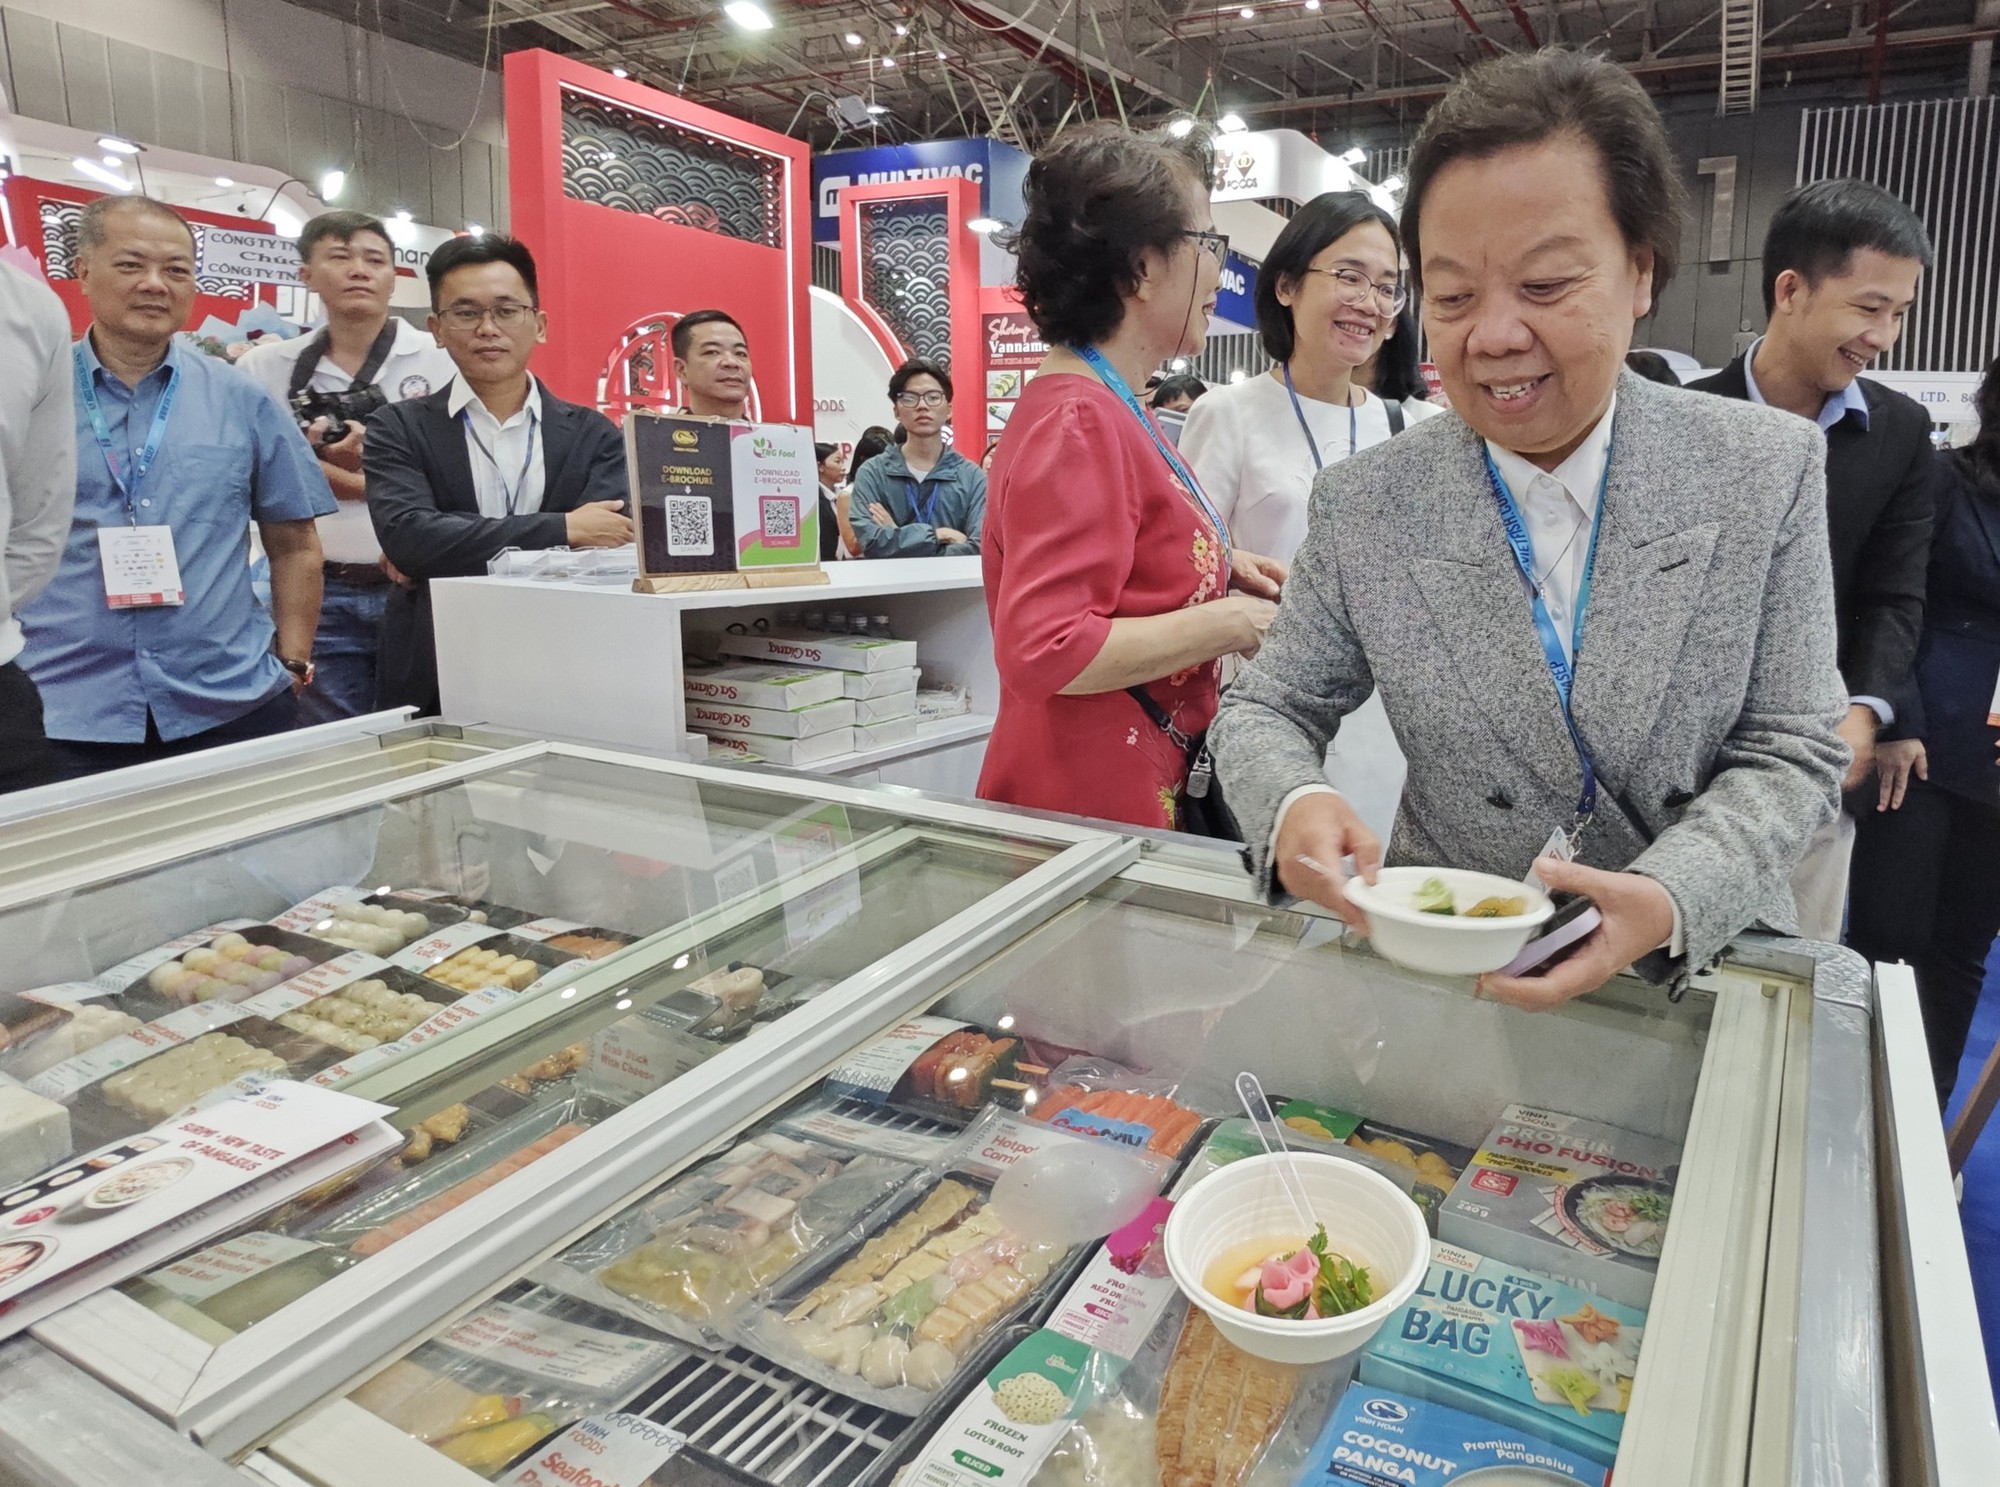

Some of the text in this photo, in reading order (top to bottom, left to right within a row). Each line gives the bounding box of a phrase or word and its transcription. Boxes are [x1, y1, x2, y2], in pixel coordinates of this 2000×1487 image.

[211, 232, 255, 247] CÔNG
[257, 237, 277, 248] TY
[239, 250, 301, 266] Chúc
[208, 262, 252, 278] CÔNG
[254, 268, 274, 279] TY
[1920, 391, 1950, 403] LTD.
[779, 449, 796, 458] Food
[660, 474, 714, 485] E-BROCHURE
[662, 465, 712, 476] DOWNLOAD
[755, 468, 801, 477] DOWNLOAD
[754, 477, 803, 485] E-BROCHURE
[768, 641, 822, 662] Sa Giang
[721, 685, 738, 699] Sa
[696, 707, 751, 728] Sa Giang
[1515, 1116, 1557, 1130] FOODS
[1519, 1109, 1548, 1121] VINH
[180, 1140, 203, 1149] OF
[218, 1135, 252, 1148] NEW
[245, 1143, 286, 1160] TASTE
[991, 1135, 1040, 1153] Hotpo
[1501, 1124, 1616, 1155] PROTEIN
[1496, 1135, 1659, 1180] PHO FUSION
[1436, 1254, 1474, 1269] FOODS
[1440, 1247, 1467, 1260] VINH
[1090, 1283, 1110, 1295] RED
[1414, 1266, 1554, 1320] LUCKY
[1400, 1307, 1492, 1356] BAG
[581, 1420, 611, 1440] VINH
[983, 1419, 1029, 1442] FROZEN
[1354, 1416, 1404, 1434] VINH HOAN
[568, 1430, 608, 1455] FOODS
[964, 1427, 1025, 1459] LOTUS ROOT
[1462, 1439, 1526, 1453] Premium
[1342, 1430, 1458, 1477] COCONUT
[1497, 1449, 1575, 1475] Pangasius
[540, 1452, 620, 1487] Seafoo
[961, 1455, 992, 1473] SLICED
[1332, 1445, 1417, 1485] PANGA
